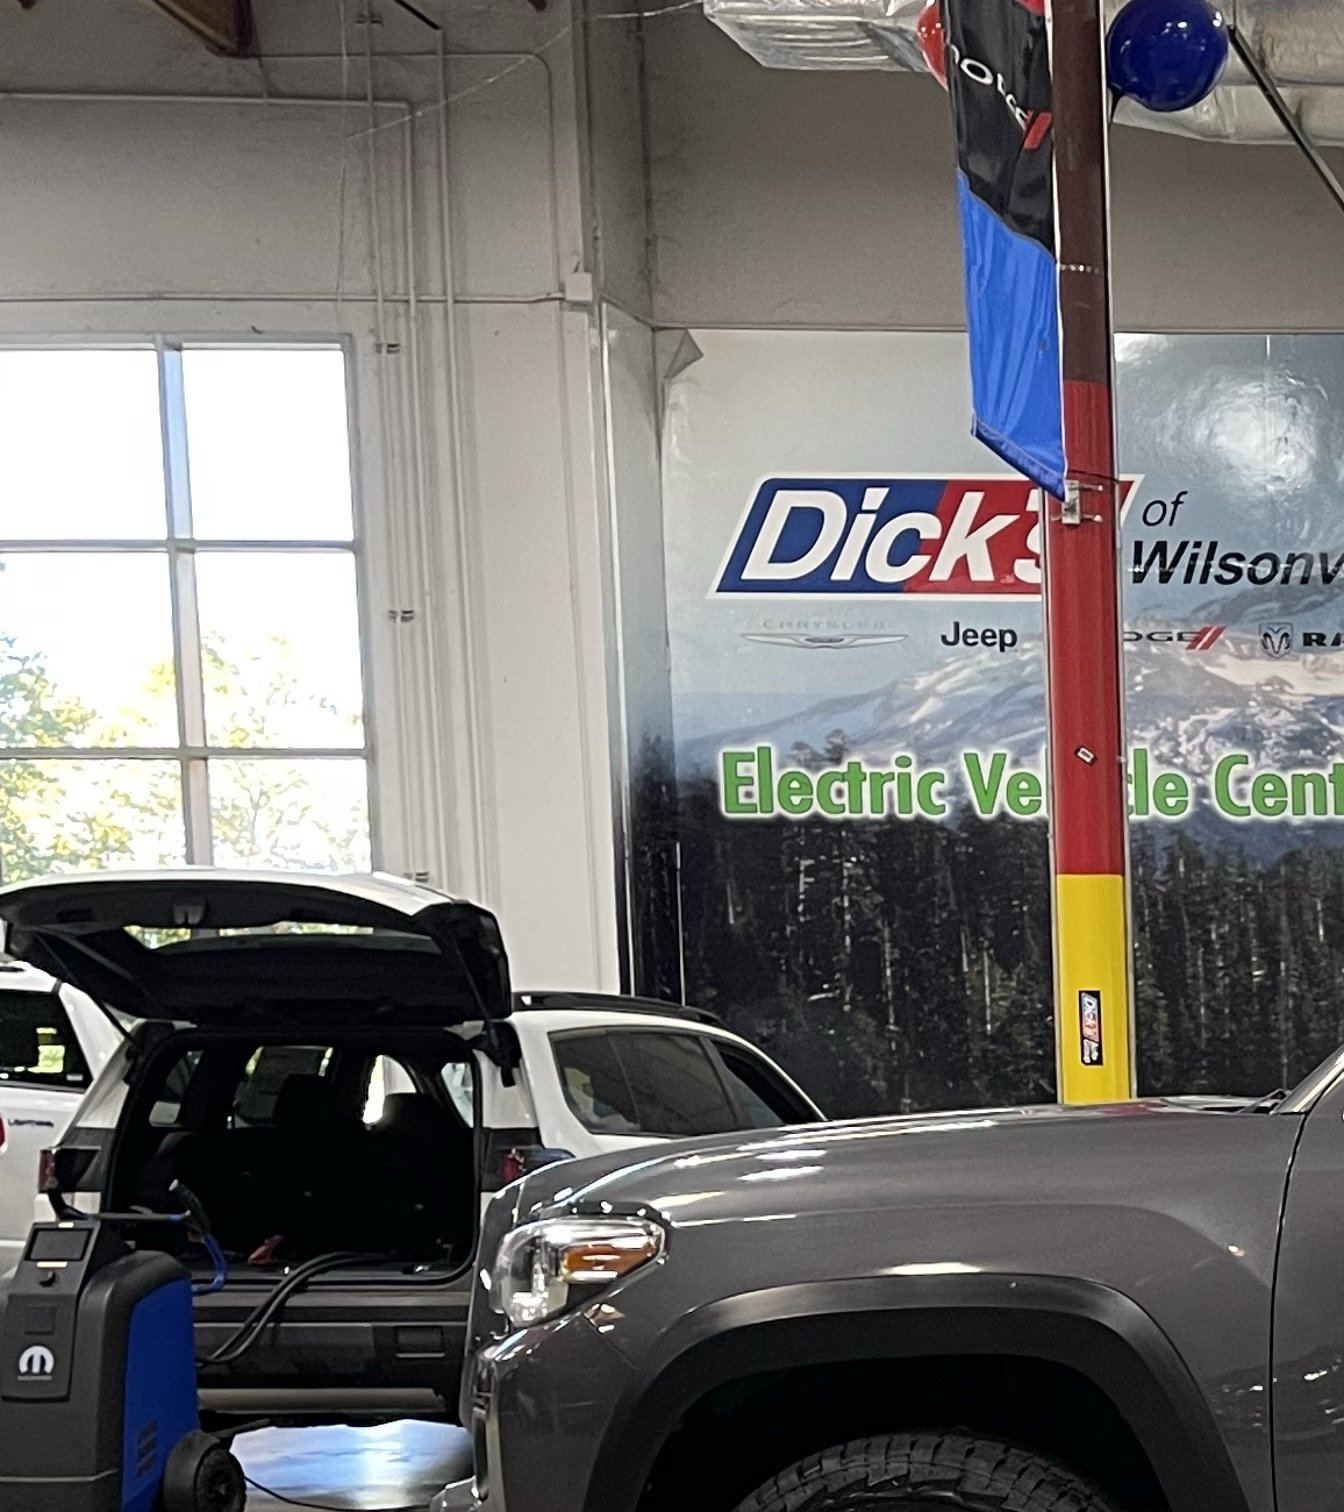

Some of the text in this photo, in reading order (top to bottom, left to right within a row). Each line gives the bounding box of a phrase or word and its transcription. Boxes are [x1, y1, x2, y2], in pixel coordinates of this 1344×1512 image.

[1142, 490, 1188, 527] of
[940, 620, 1018, 652] Jeep
[722, 746, 946, 816] Electric
[963, 747, 1189, 816] Vele
